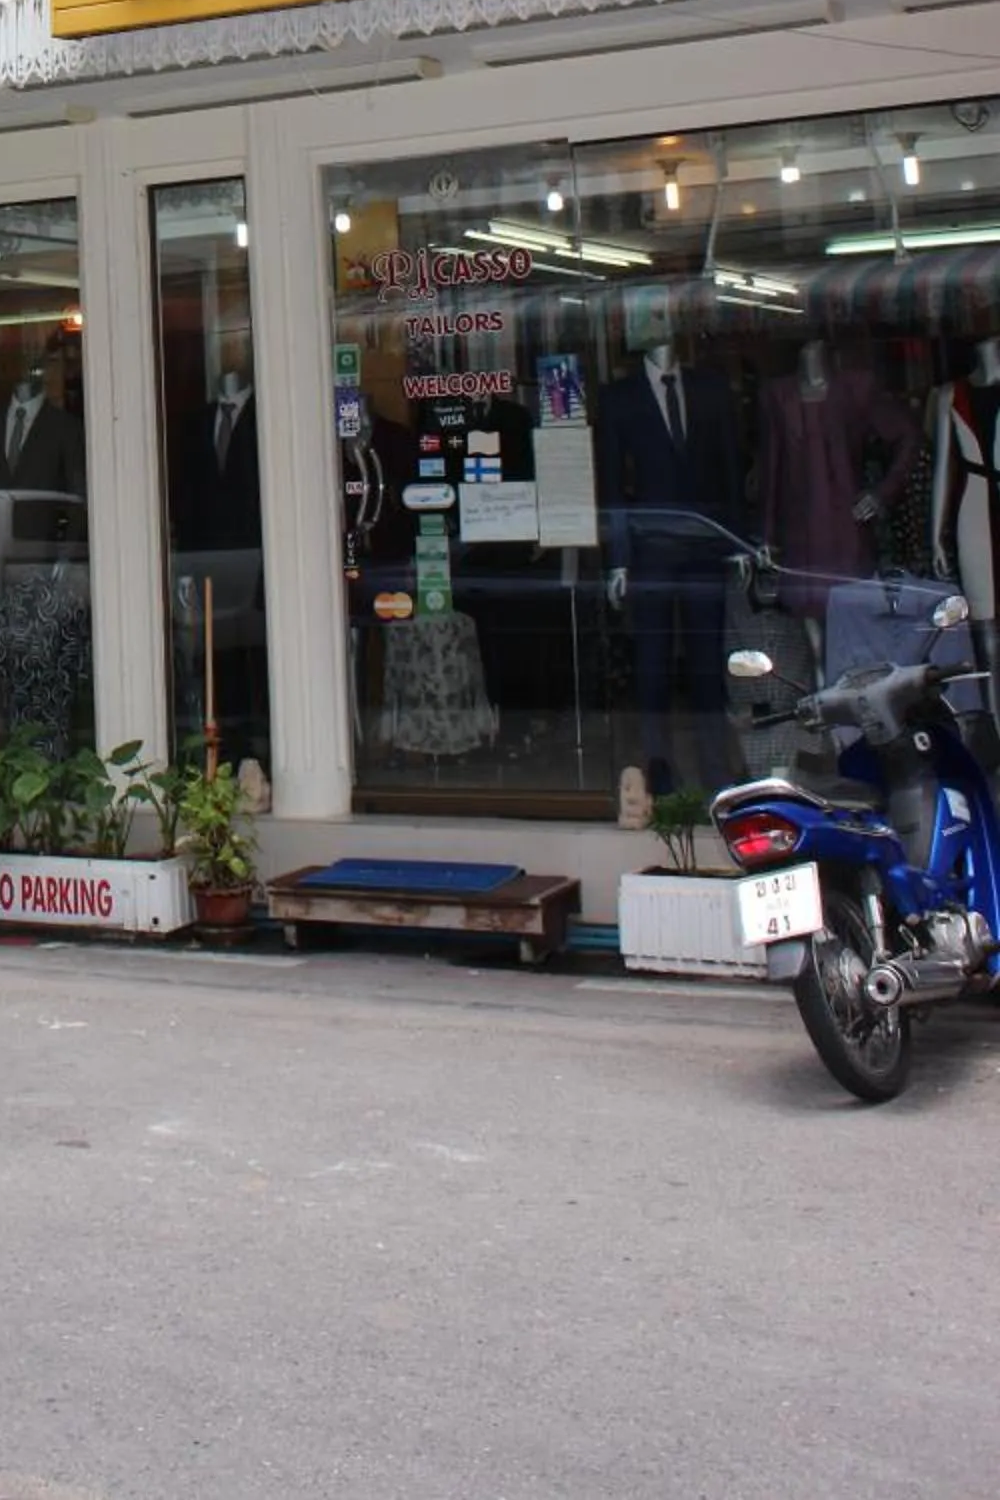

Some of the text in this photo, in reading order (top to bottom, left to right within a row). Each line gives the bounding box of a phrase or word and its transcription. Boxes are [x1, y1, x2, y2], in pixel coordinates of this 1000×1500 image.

[405, 311, 504, 338] TAILORS
[403, 371, 513, 399] WELCOME
[439, 413, 465, 427] VISA
[21, 875, 113, 917] PARKING
